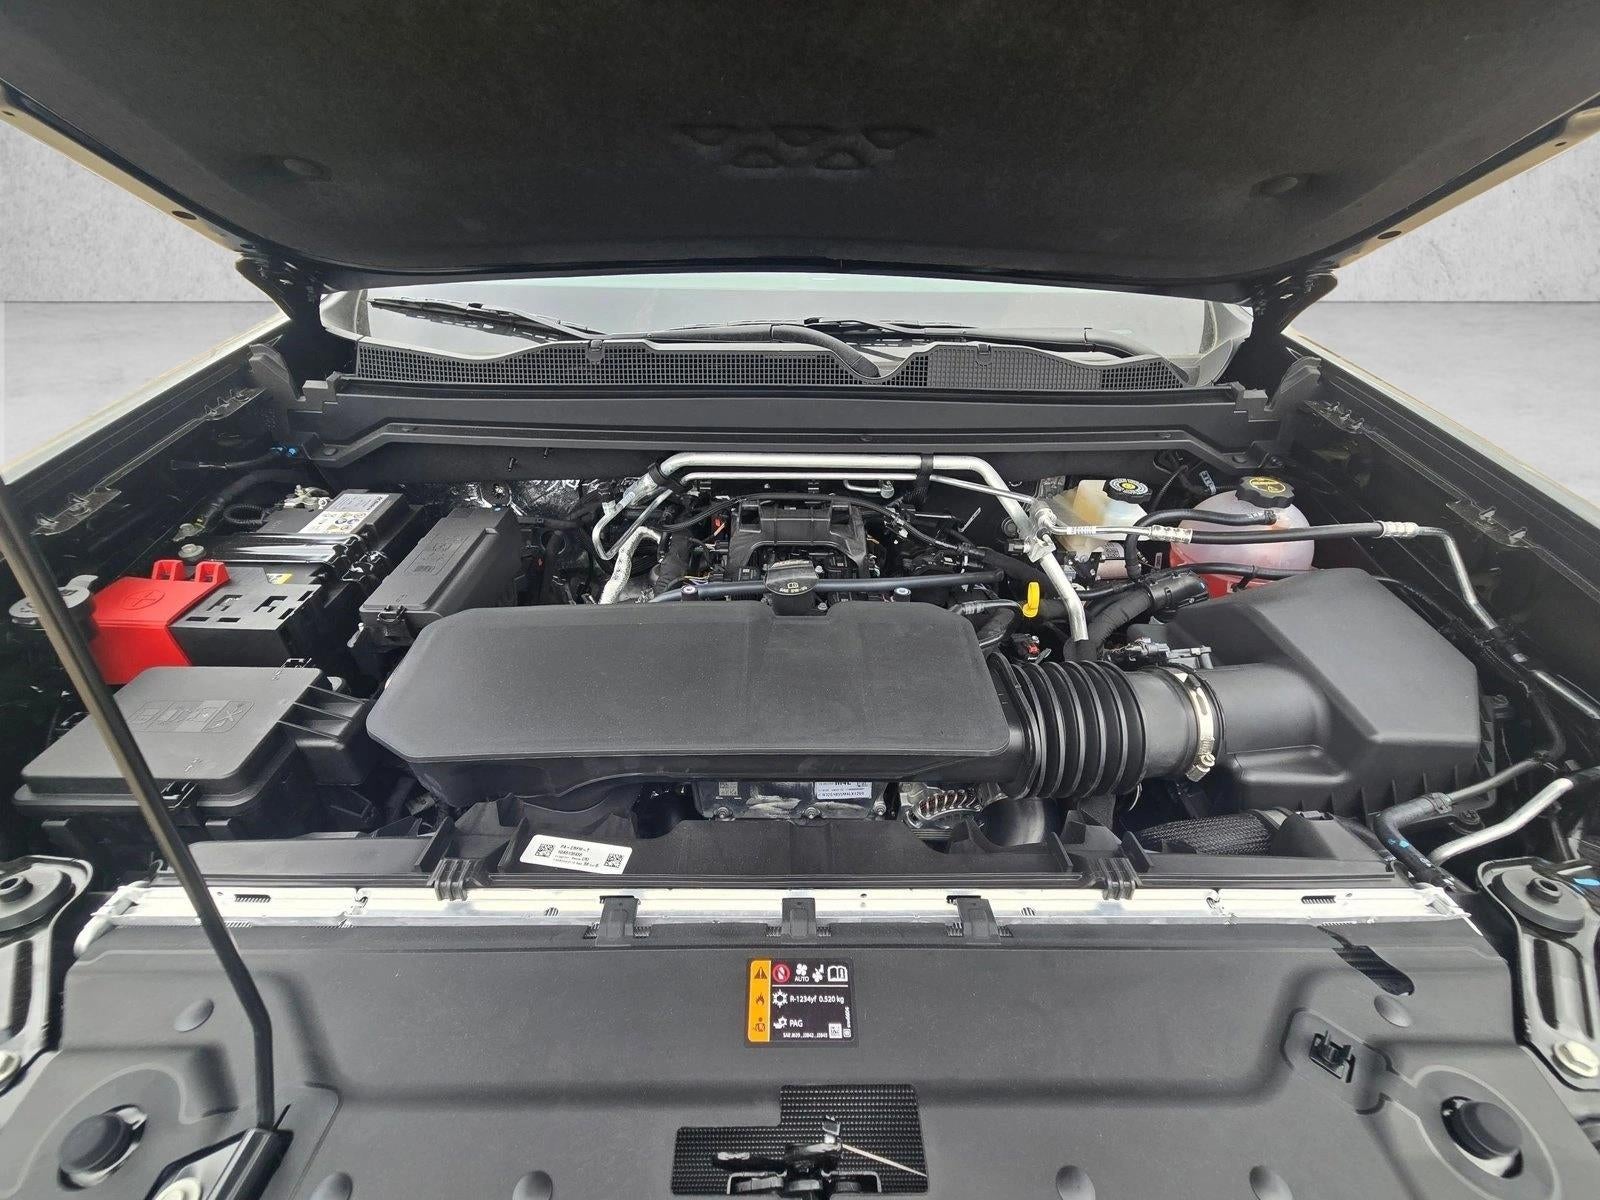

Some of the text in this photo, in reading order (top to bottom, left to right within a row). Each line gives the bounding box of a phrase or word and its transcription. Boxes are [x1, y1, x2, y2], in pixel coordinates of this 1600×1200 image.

[789, 995, 845, 1005] R-1234yf 0.520 kg
[789, 1019, 803, 1028] PAG
